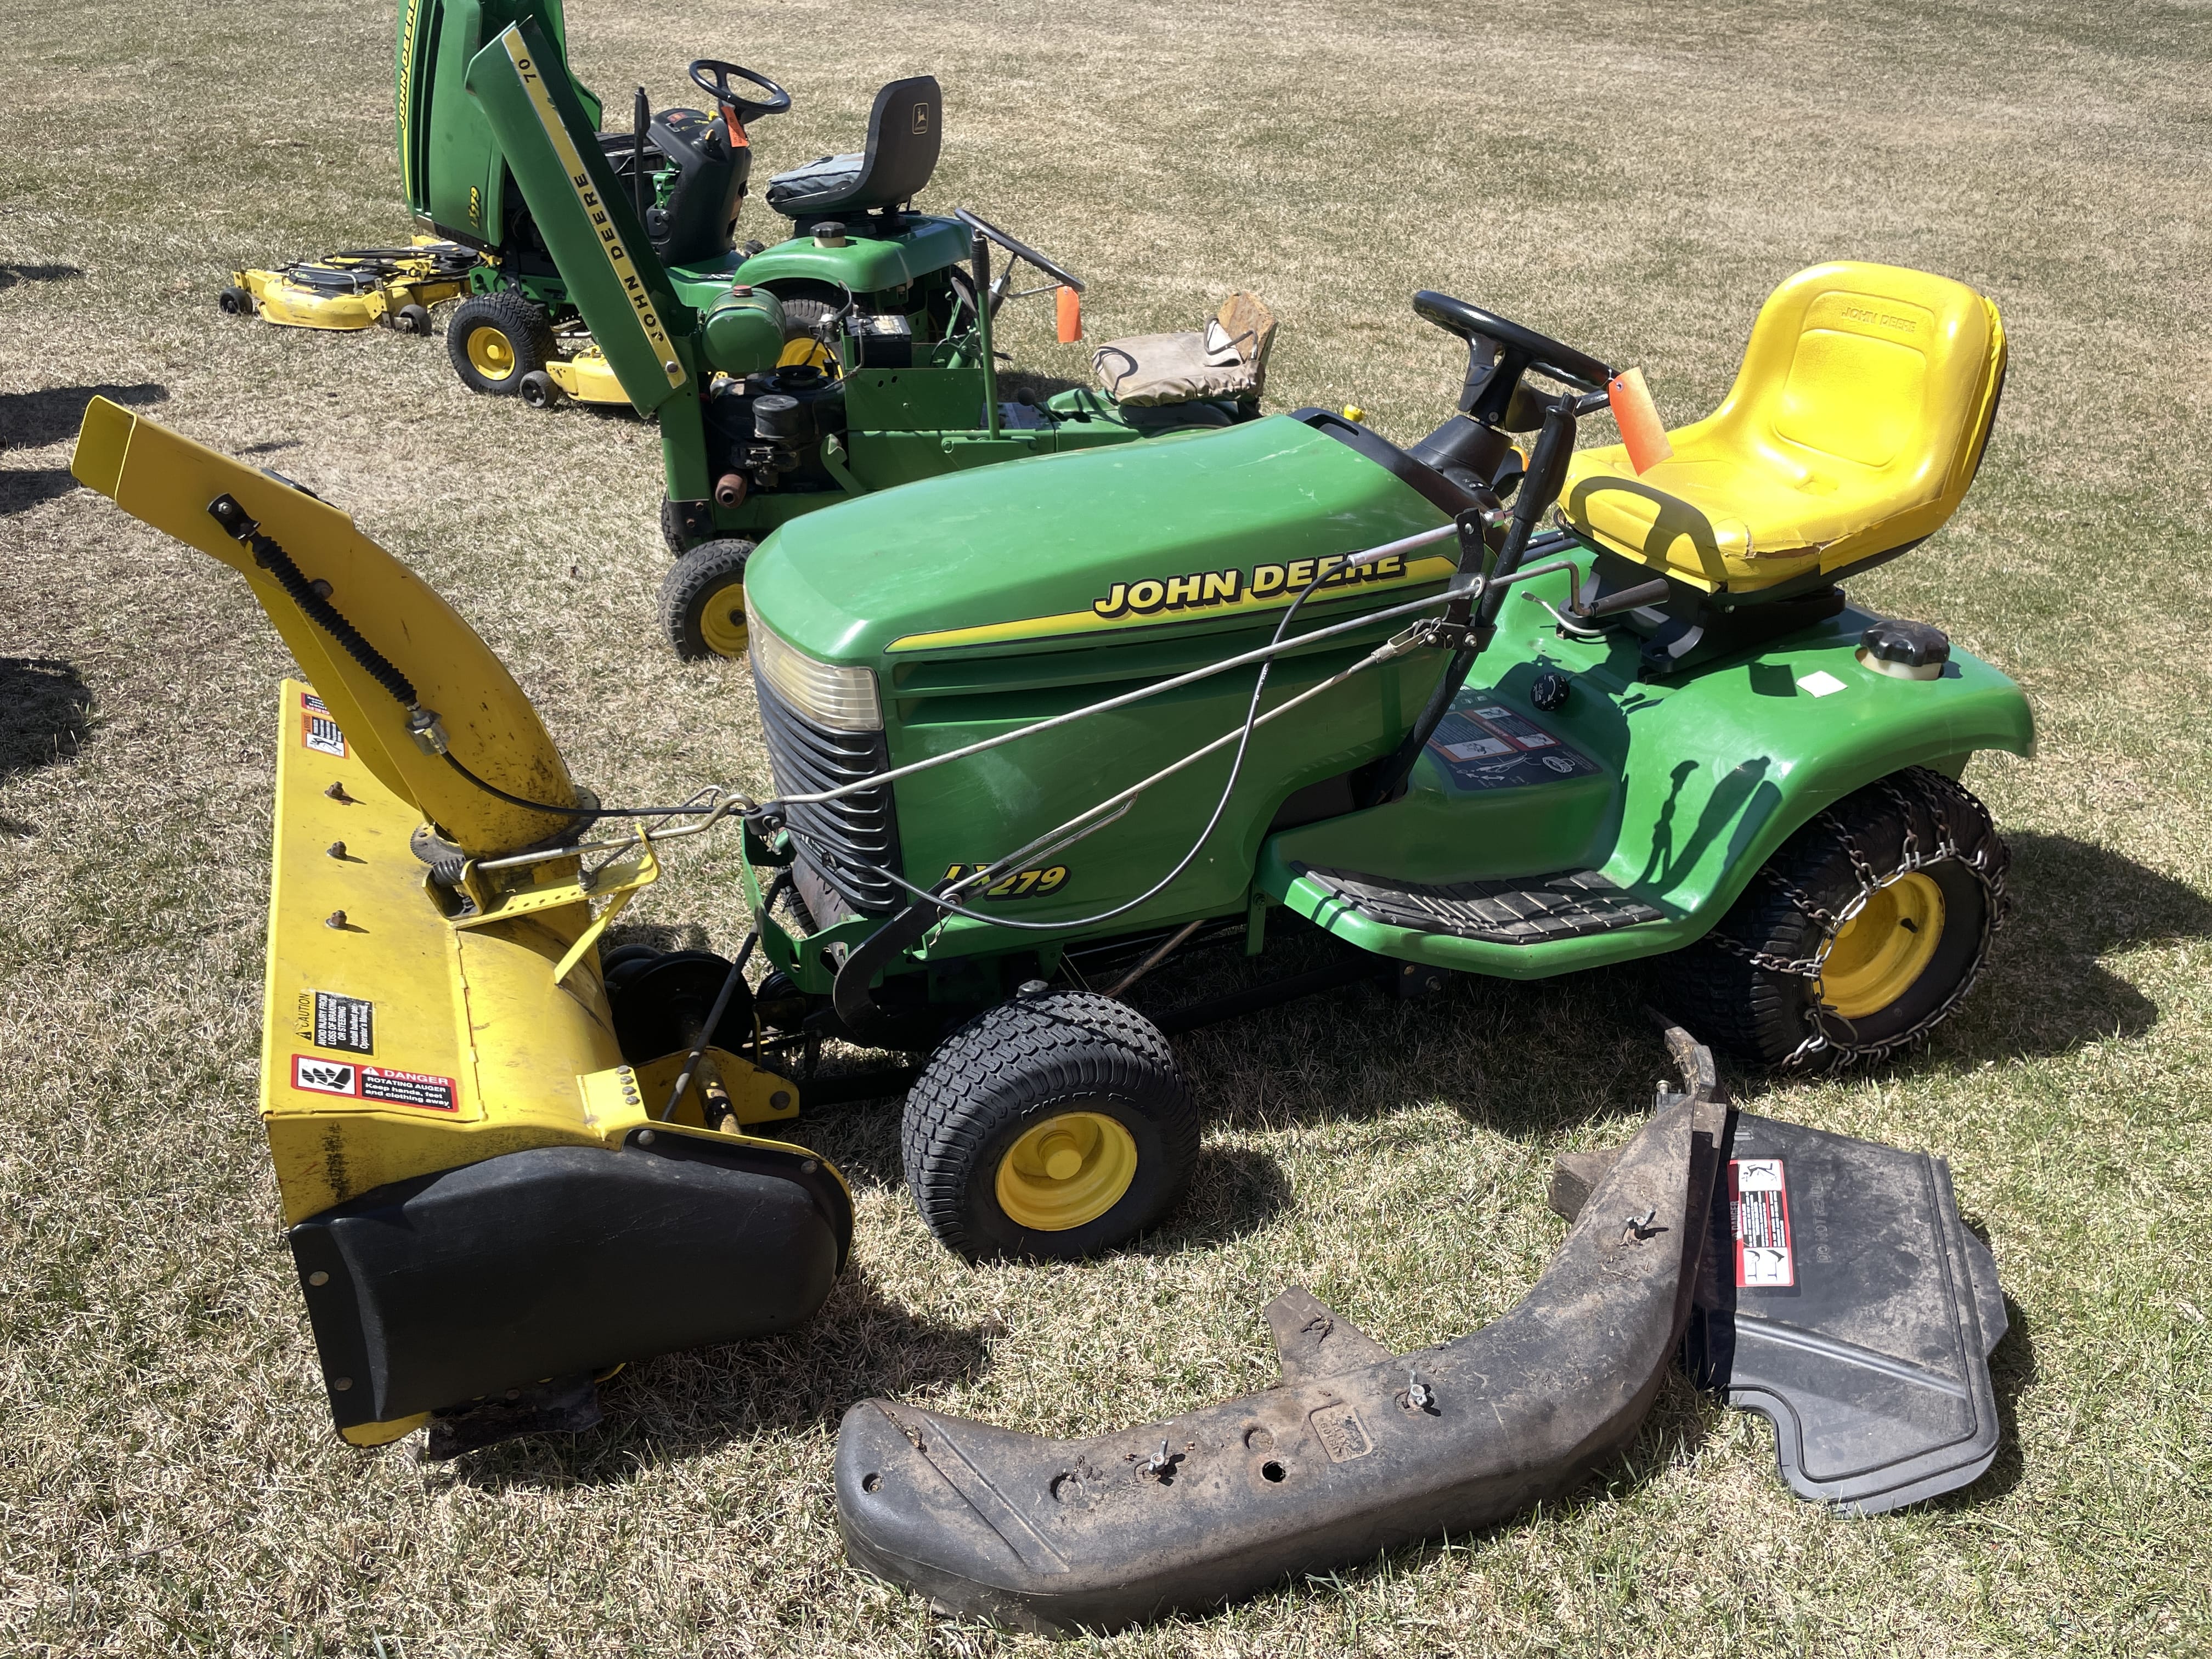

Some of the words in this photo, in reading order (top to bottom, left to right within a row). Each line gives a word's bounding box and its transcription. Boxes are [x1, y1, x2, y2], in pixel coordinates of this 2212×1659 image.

[517, 58, 537, 84] 70
[399, 66, 413, 130] JOHN
[574, 172, 624, 260] DEERE
[624, 275, 666, 343] JOHN
[1841, 307, 1878, 324] JOHN
[1879, 314, 1917, 334] DEERE
[1093, 569, 1242, 616] JOHN
[298, 993, 311, 1028] CAUTION
[318, 995, 328, 1010] FROM
[328, 998, 337, 1022] BRAKING
[318, 1009, 328, 1029] INJURY
[328, 1021, 337, 1030] OF
[337, 1006, 347, 1031] STEERING
[318, 1029, 327, 1046] AVOID
[328, 1030, 337, 1045] LOSS
[337, 1032, 347, 1041] OR
[349, 1031, 358, 1046] Install
[359, 1023, 370, 1049] Operator's
[367, 1076, 413, 1088] ROTATING
[415, 1083, 447, 1093] AUGER
[384, 1069, 449, 1085] DANGER
[365, 1082, 390, 1093] Keep
[392, 1086, 424, 1097] hands,
[385, 1092, 425, 1103] clothing
[1730, 1200, 1741, 1231] DANGER
[1815, 1244, 1831, 1263] DO
